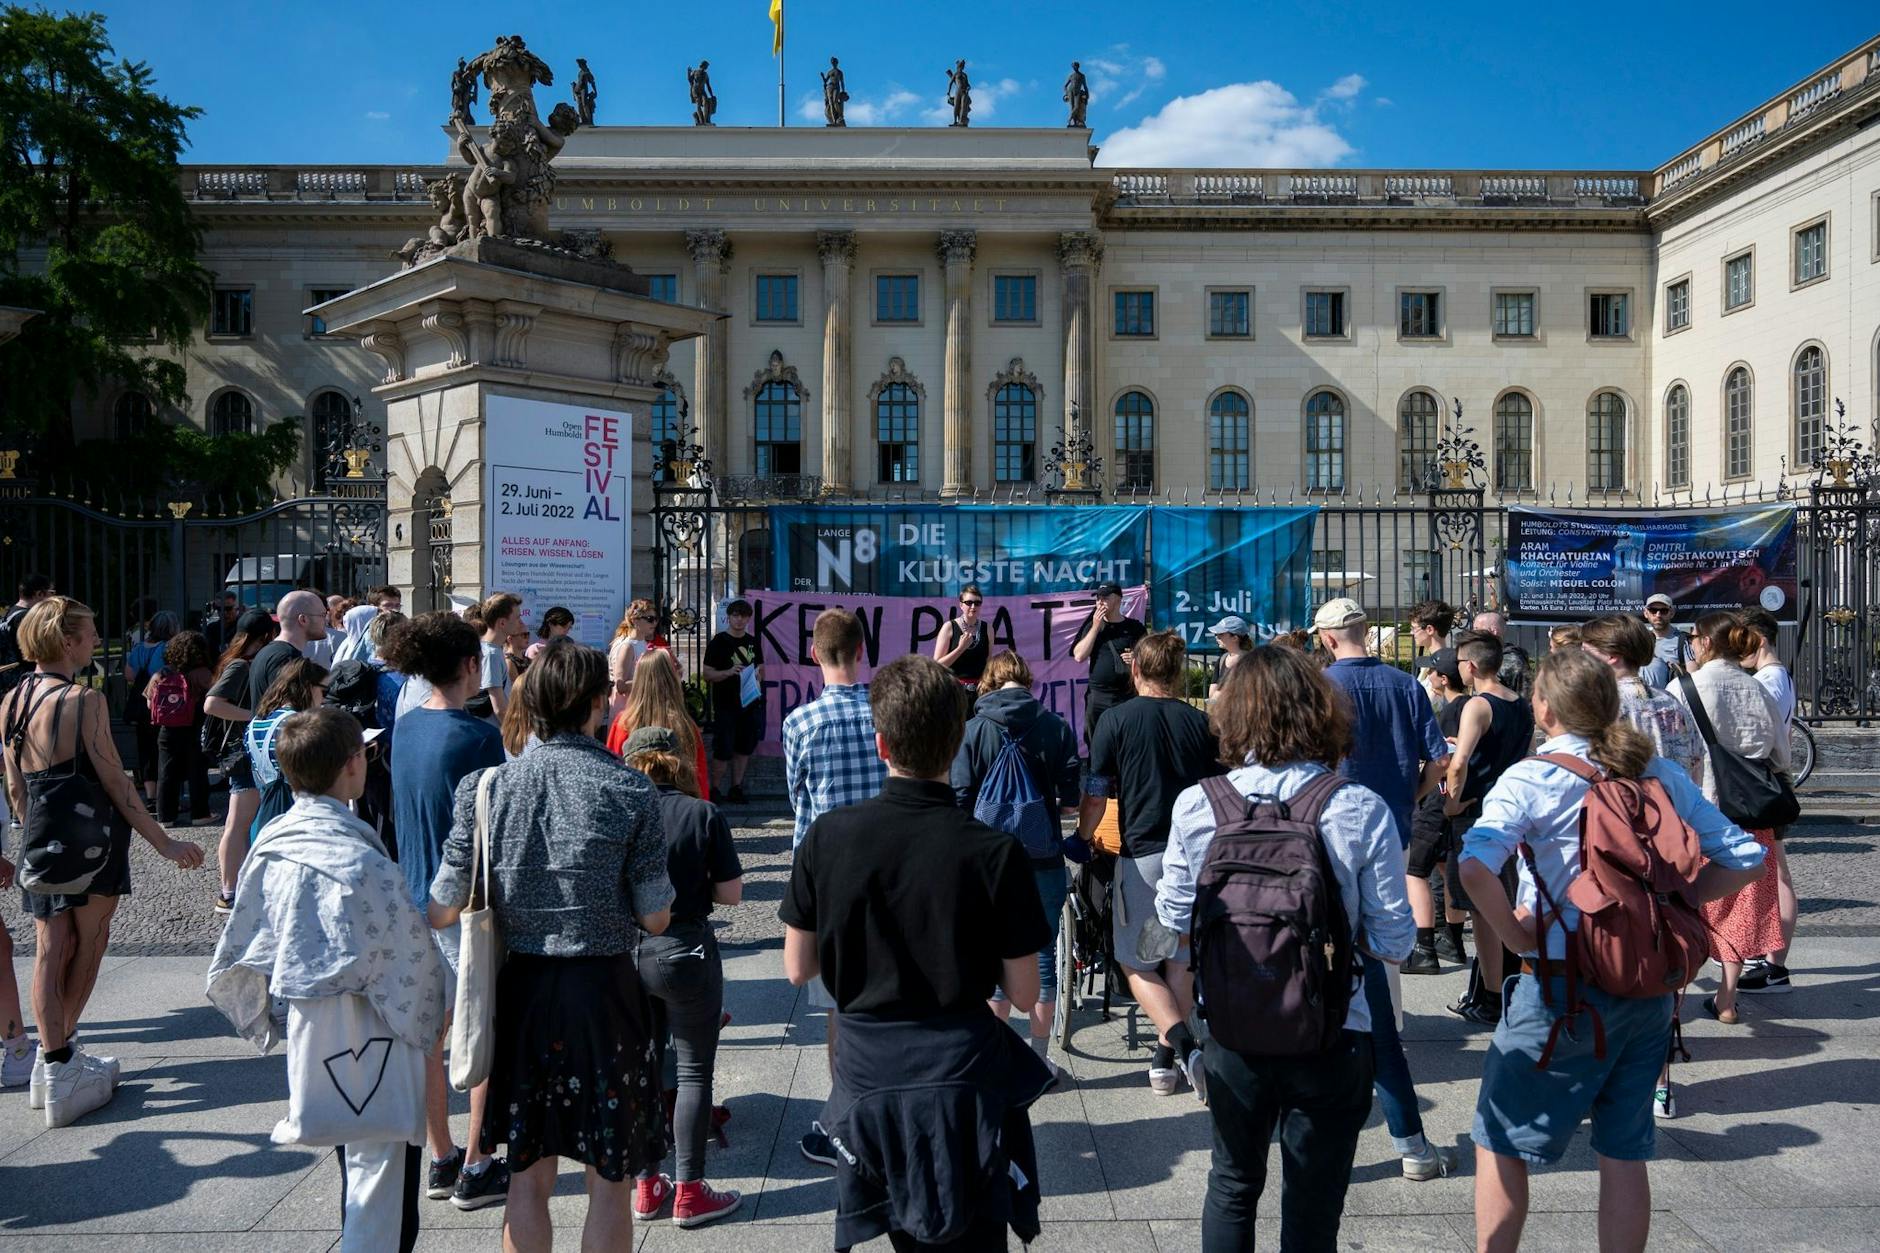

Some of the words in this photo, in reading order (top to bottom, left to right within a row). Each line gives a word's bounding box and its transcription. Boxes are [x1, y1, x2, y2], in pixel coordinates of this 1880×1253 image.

[556, 198, 714, 211] UMBOLDT
[754, 198, 1006, 212] UNIVERSITAET
[562, 421, 582, 431] Open
[545, 428, 582, 439] Humboldt
[501, 483, 522, 497] 29.
[525, 485, 551, 499] Juni
[501, 502, 513, 515] 2.
[516, 503, 538, 517] Juli
[542, 504, 574, 518] 2022
[1520, 520, 1568, 529] HUMBOLDTS
[818, 529, 850, 537] LANGE
[899, 523, 946, 546] DIE
[1520, 528, 1556, 536] LEITUNG:
[1558, 529, 1609, 537] CONSTANTIN
[501, 537, 530, 545] ALLES
[532, 538, 550, 546] AUF
[552, 539, 590, 548] ANFANG:
[1520, 542, 1549, 551] ARAM
[1648, 543, 1687, 551] DMITRI
[501, 547, 535, 556] KRISEN.
[539, 549, 574, 558] WISSEN.
[576, 549, 604, 559] LÖSEN
[1520, 552, 1611, 561] KHACHATURIAN
[1646, 549, 1760, 561] SCHOSTAKOWITSCH
[899, 554, 1025, 583] KLÜGSTE
[1034, 559, 1131, 584] NACHT
[1556, 561, 1568, 569] für
[1646, 562, 1694, 570] Symphonie
[1696, 560, 1709, 568] Nr.
[1720, 559, 1729, 567] in
[1538, 569, 1580, 577] Orchester
[794, 578, 812, 586] DER
[1520, 579, 1547, 588] Solist:
[1550, 580, 1589, 588] MIGUEL
[1591, 579, 1626, 588] COLOM
[1175, 590, 1200, 612] 2.
[1208, 590, 1252, 613] Juli
[754, 599, 883, 668] KEN
[909, 600, 1098, 661] PAT
